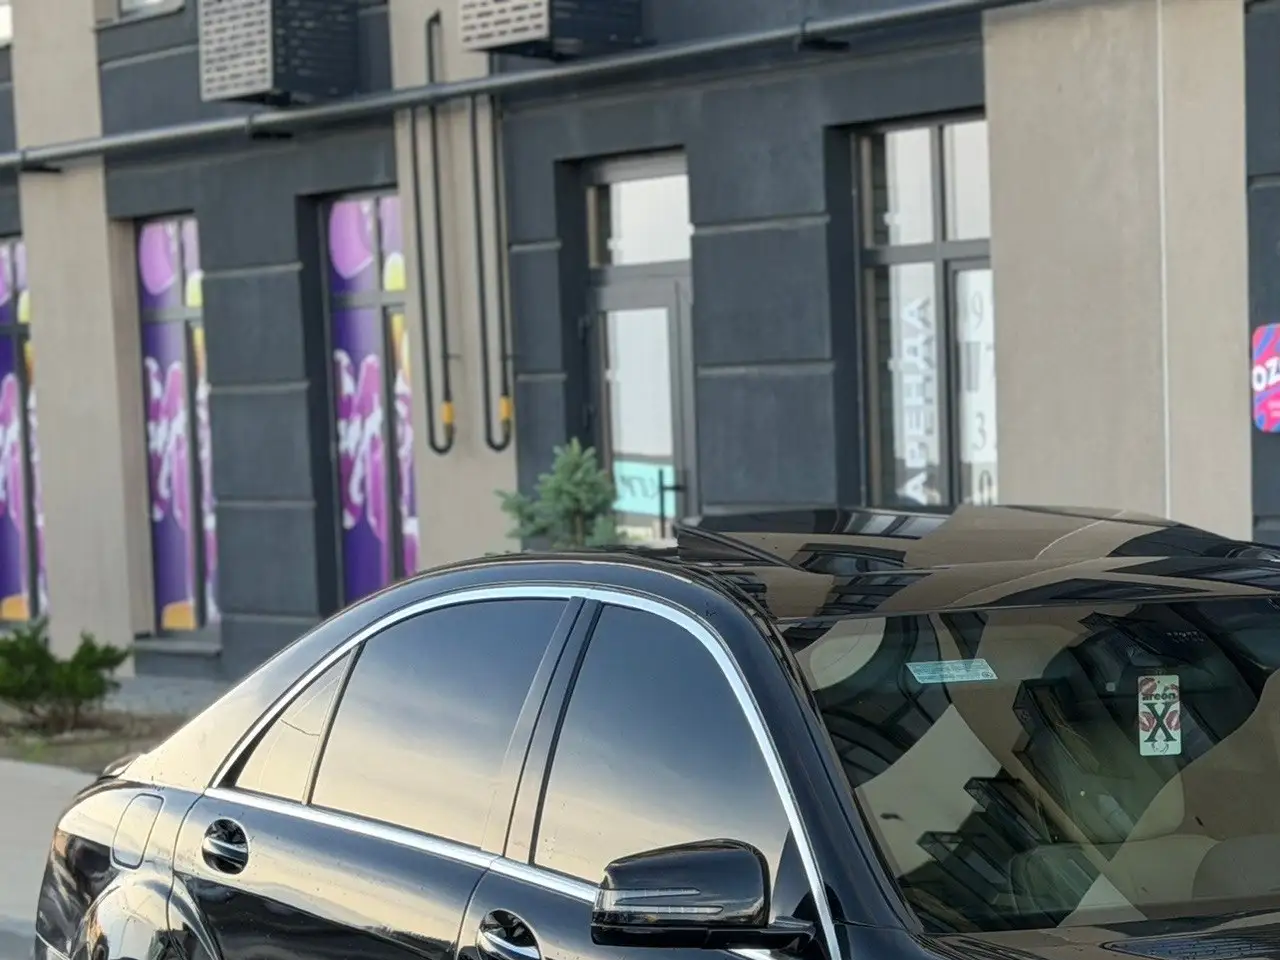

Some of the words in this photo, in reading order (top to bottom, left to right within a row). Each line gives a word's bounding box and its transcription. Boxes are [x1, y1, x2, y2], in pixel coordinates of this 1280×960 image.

[900, 297, 930, 506] АРЕНДА
[1142, 691, 1176, 701] areon
[1143, 703, 1177, 743] X
